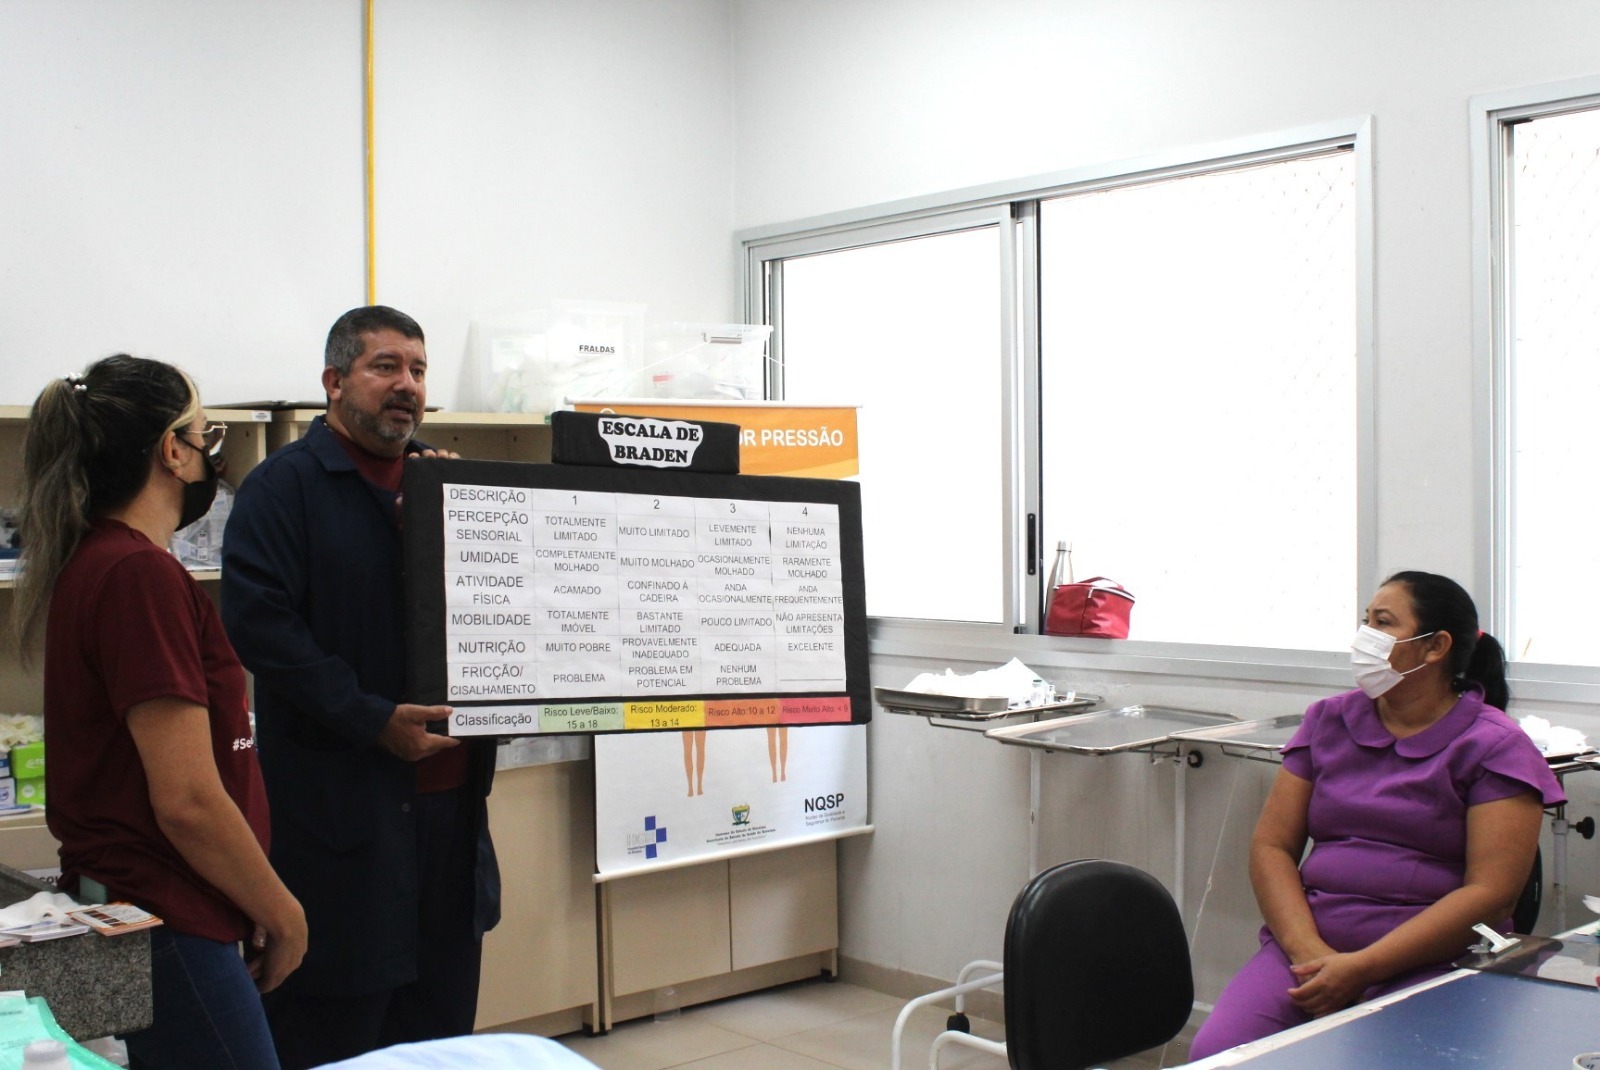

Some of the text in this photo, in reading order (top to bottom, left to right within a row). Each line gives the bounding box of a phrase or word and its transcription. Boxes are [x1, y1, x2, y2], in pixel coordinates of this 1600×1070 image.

[579, 345, 615, 353] FRALDAS
[602, 421, 699, 441] ESCALA DE
[761, 426, 843, 446] PRESSÃO
[615, 445, 688, 463] BRADEN
[450, 488, 526, 504] DESCRIÇÃO
[572, 495, 577, 505] 1
[653, 499, 660, 509] 2
[730, 503, 736, 513] 3
[802, 507, 808, 516] 4
[448, 510, 528, 526] PERCEPÇÃO
[545, 516, 606, 527] TOTALMENTE
[619, 526, 690, 538] MUITO LIMITADO
[709, 524, 756, 534] LEVEMENTE
[787, 527, 825, 536] NENHUMA
[456, 529, 522, 542] SENSORIAL
[554, 531, 598, 541] LIMITADO
[715, 538, 752, 546] LIMITADO
[786, 540, 827, 550] LIMITAÇÃO
[460, 551, 519, 564] UMIDADE
[536, 550, 616, 560] COMPLETAMENTE
[698, 555, 770, 565] OCASIONALMENTE
[620, 557, 694, 568] MUITO MOLHADO
[783, 557, 831, 566] RARAMENTE
[554, 563, 599, 572] MOLHADO
[715, 567, 754, 576] MOLHADO
[788, 570, 827, 578] MOLHADO
[456, 576, 524, 587] ATIVIDADE
[628, 580, 680, 590] CONFINADO
[554, 586, 601, 595] ACAMADO
[473, 592, 510, 605] FÍSICA
[640, 593, 678, 603] CADEIRA
[699, 595, 772, 604] OCASIONALMENTE
[452, 614, 531, 626] MOBILIDADE
[547, 610, 609, 620] TOTALMENTE
[637, 611, 683, 620] BASTANTE
[776, 612, 793, 621] NÃO
[702, 618, 772, 626] POUCO LIMITADO
[561, 623, 596, 632] IMÓVEL
[640, 624, 680, 633] LIMITADO
[786, 624, 833, 635] LIMITAÇÕES
[622, 637, 697, 646] PROVAVELMENTE
[458, 640, 525, 655] NUTRIÇÃO
[546, 642, 611, 652] MUITO POBRE
[715, 643, 762, 652] ADEQUADA
[788, 643, 833, 651] EXCELENTE
[632, 650, 689, 659] INADEQUADO
[462, 664, 523, 680] FRICÇÃO/
[628, 665, 692, 675] PROBLEMA EM
[720, 665, 756, 673] NENHUM
[553, 674, 605, 683] PROBLEMA
[637, 678, 686, 688] POTENCIAL
[716, 677, 762, 686] PROBLEMA
[450, 684, 536, 696] CISALHAMENTO
[544, 706, 618, 716] Risco Leve/Baixo:
[630, 703, 697, 714] Risco Moderado:
[709, 708, 730, 716] Risco
[767, 706, 775, 714] 12
[455, 714, 532, 727] Classificação
[567, 721, 577, 729] 15
[588, 720, 598, 728] 18
[650, 719, 660, 727] 13
[805, 793, 844, 813] NQSP
